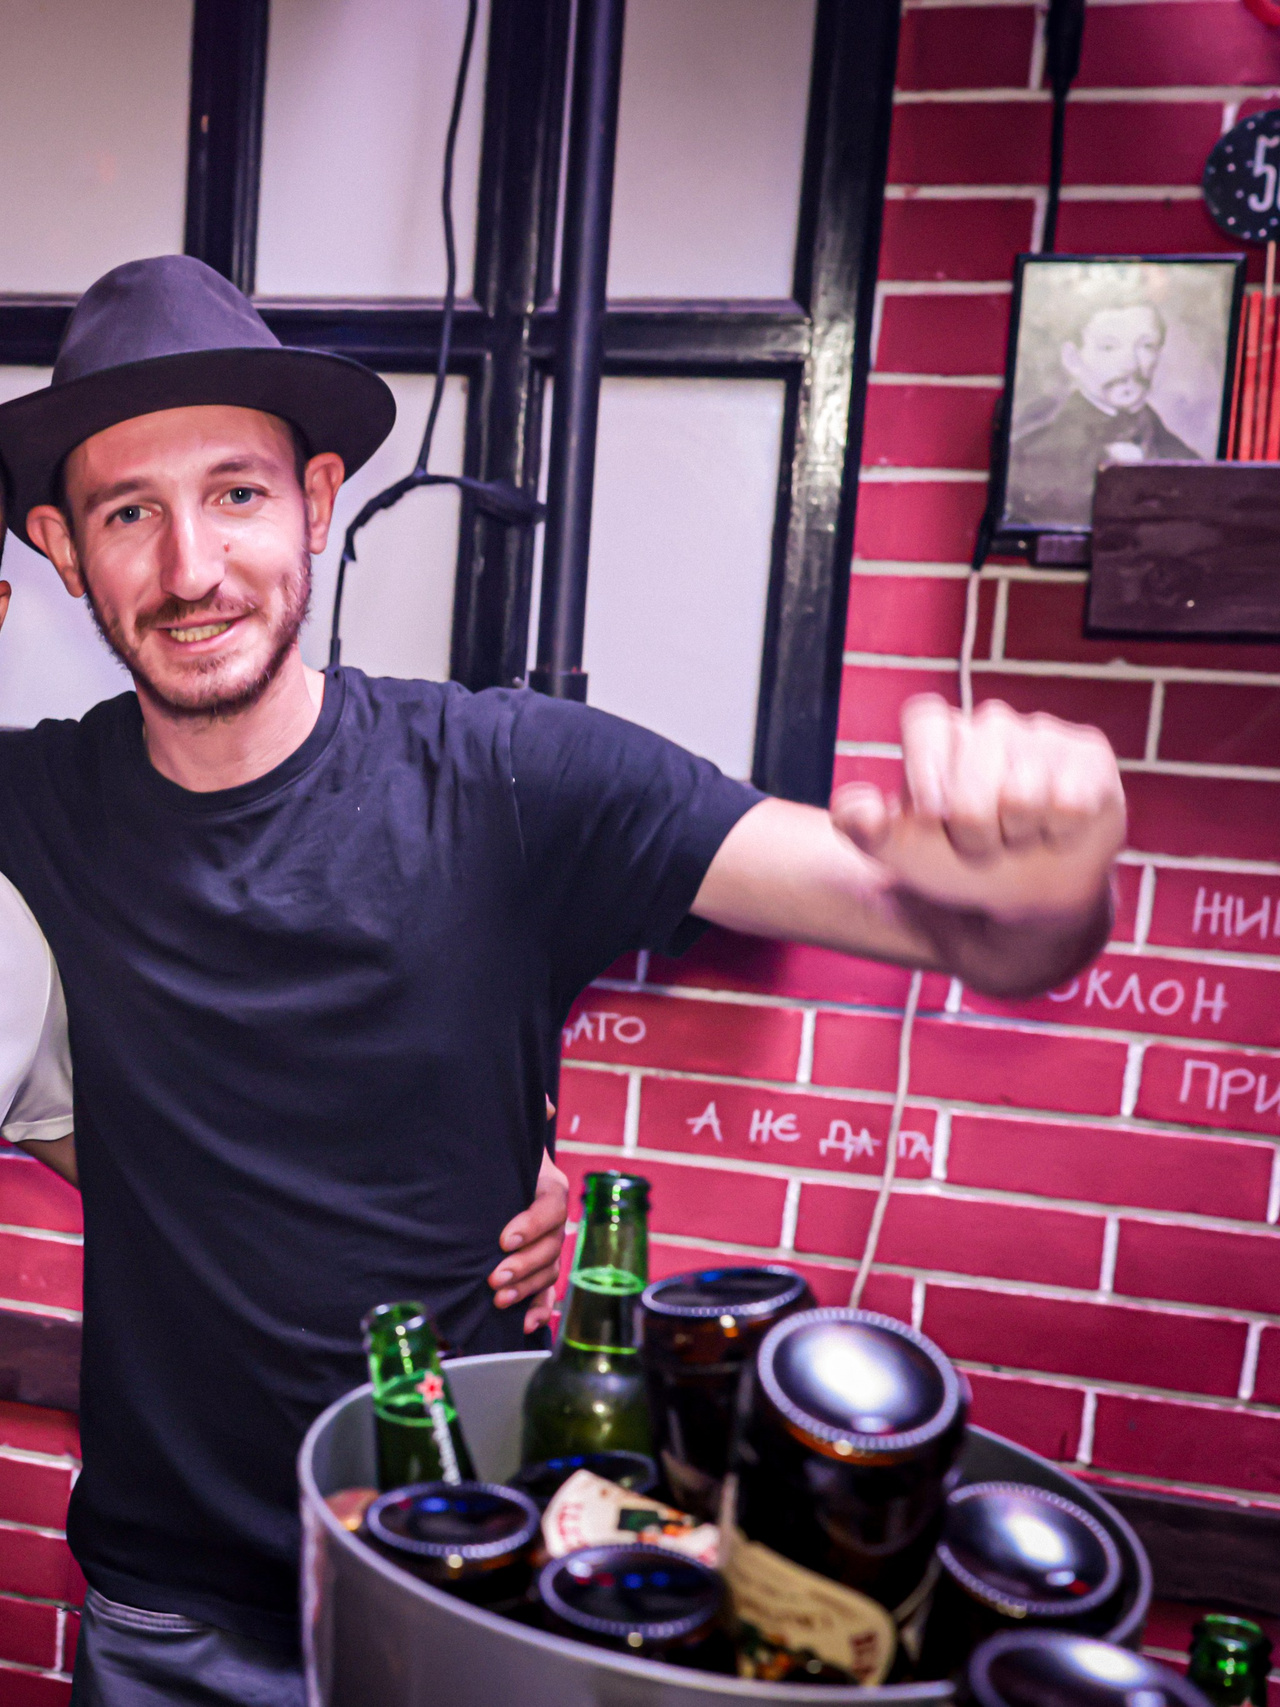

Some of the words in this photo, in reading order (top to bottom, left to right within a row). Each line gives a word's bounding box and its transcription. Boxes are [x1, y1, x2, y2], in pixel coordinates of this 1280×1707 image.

[1247, 134, 1280, 212] 5
[1192, 886, 1280, 940] ЖИ
[686, 1101, 723, 1143] А
[749, 1109, 800, 1143] НЕ
